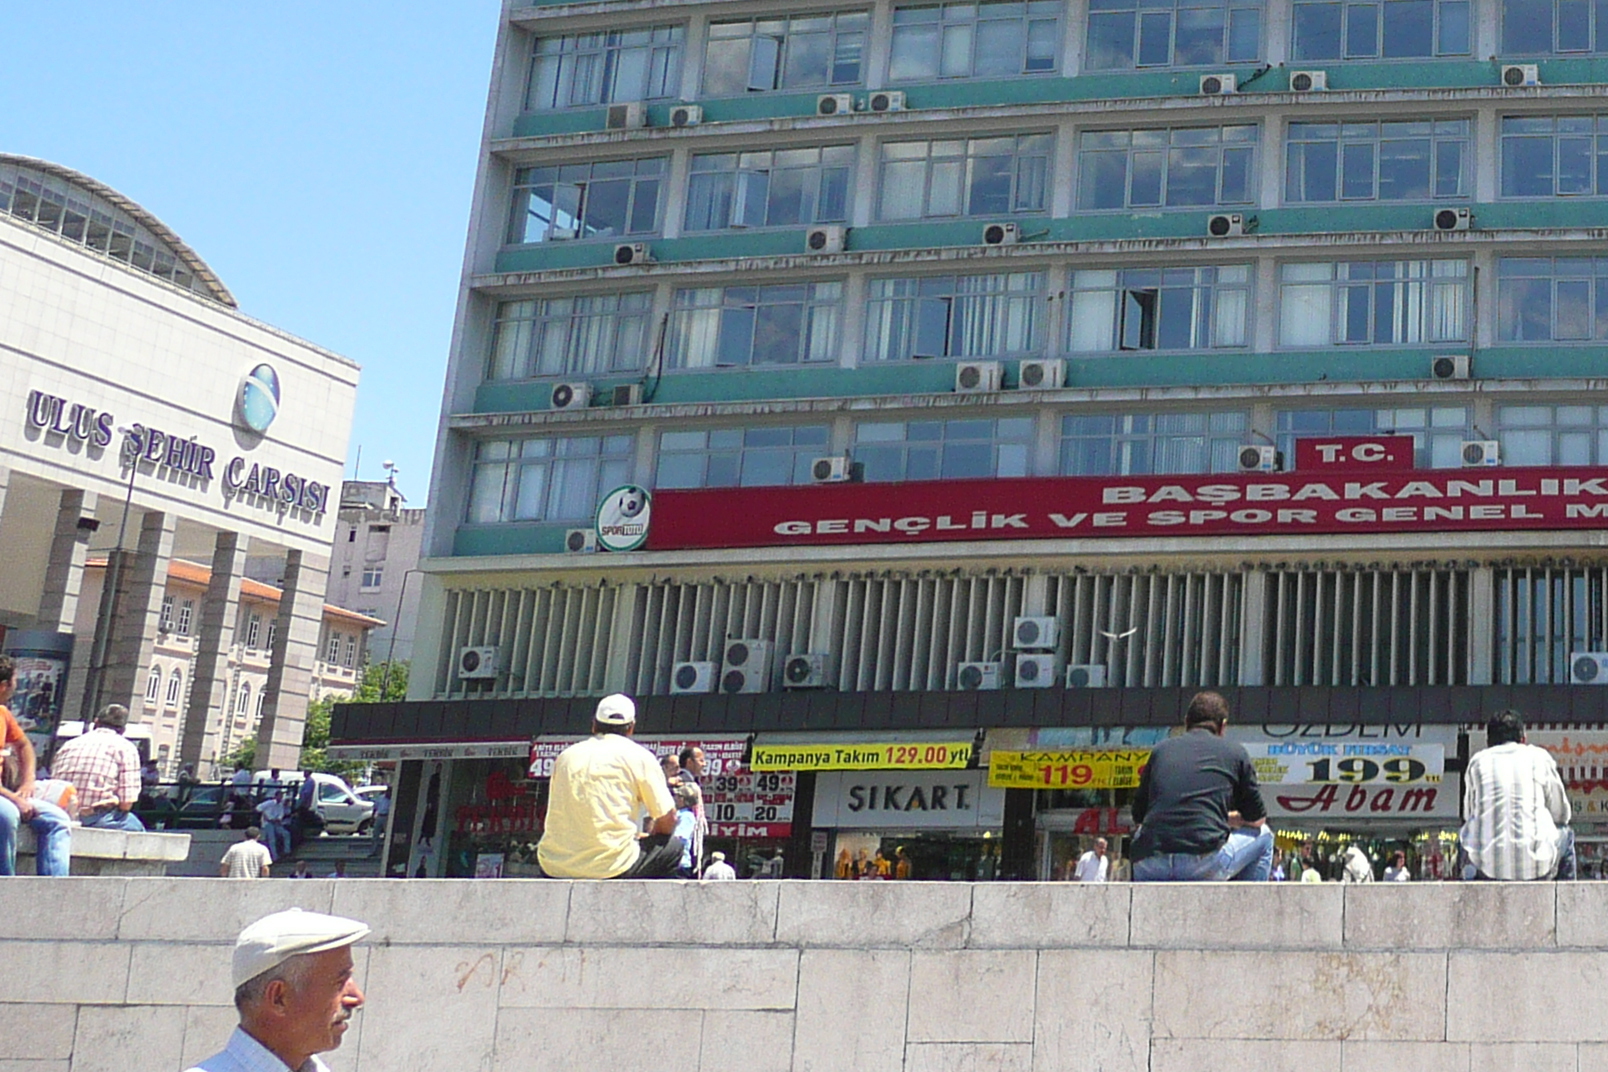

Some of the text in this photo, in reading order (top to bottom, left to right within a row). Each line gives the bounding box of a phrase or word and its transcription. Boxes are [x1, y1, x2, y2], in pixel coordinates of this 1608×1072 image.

[29, 389, 115, 447] ULUS
[1315, 443, 1395, 463] T.C.
[773, 510, 1030, 536] GENÇLİK
[1048, 512, 1129, 529] VE
[1146, 508, 1317, 527] SPOR
[1335, 504, 1544, 523] GENEL
[755, 751, 831, 767] Kampanya
[836, 749, 880, 764] Takım
[886, 746, 947, 764] 129.00
[1020, 752, 1150, 763] KAMPANY
[1267, 741, 1338, 756] BÜYÜK
[529, 758, 556, 777] 49
[1038, 764, 1093, 785] 119
[1305, 757, 1426, 783] 199
[716, 776, 738, 792] 39
[757, 775, 780, 791] 49
[1275, 784, 1438, 813] Abam
[716, 804, 735, 821] 10
[754, 806, 777, 821] 20
[710, 823, 768, 837] İYİM
